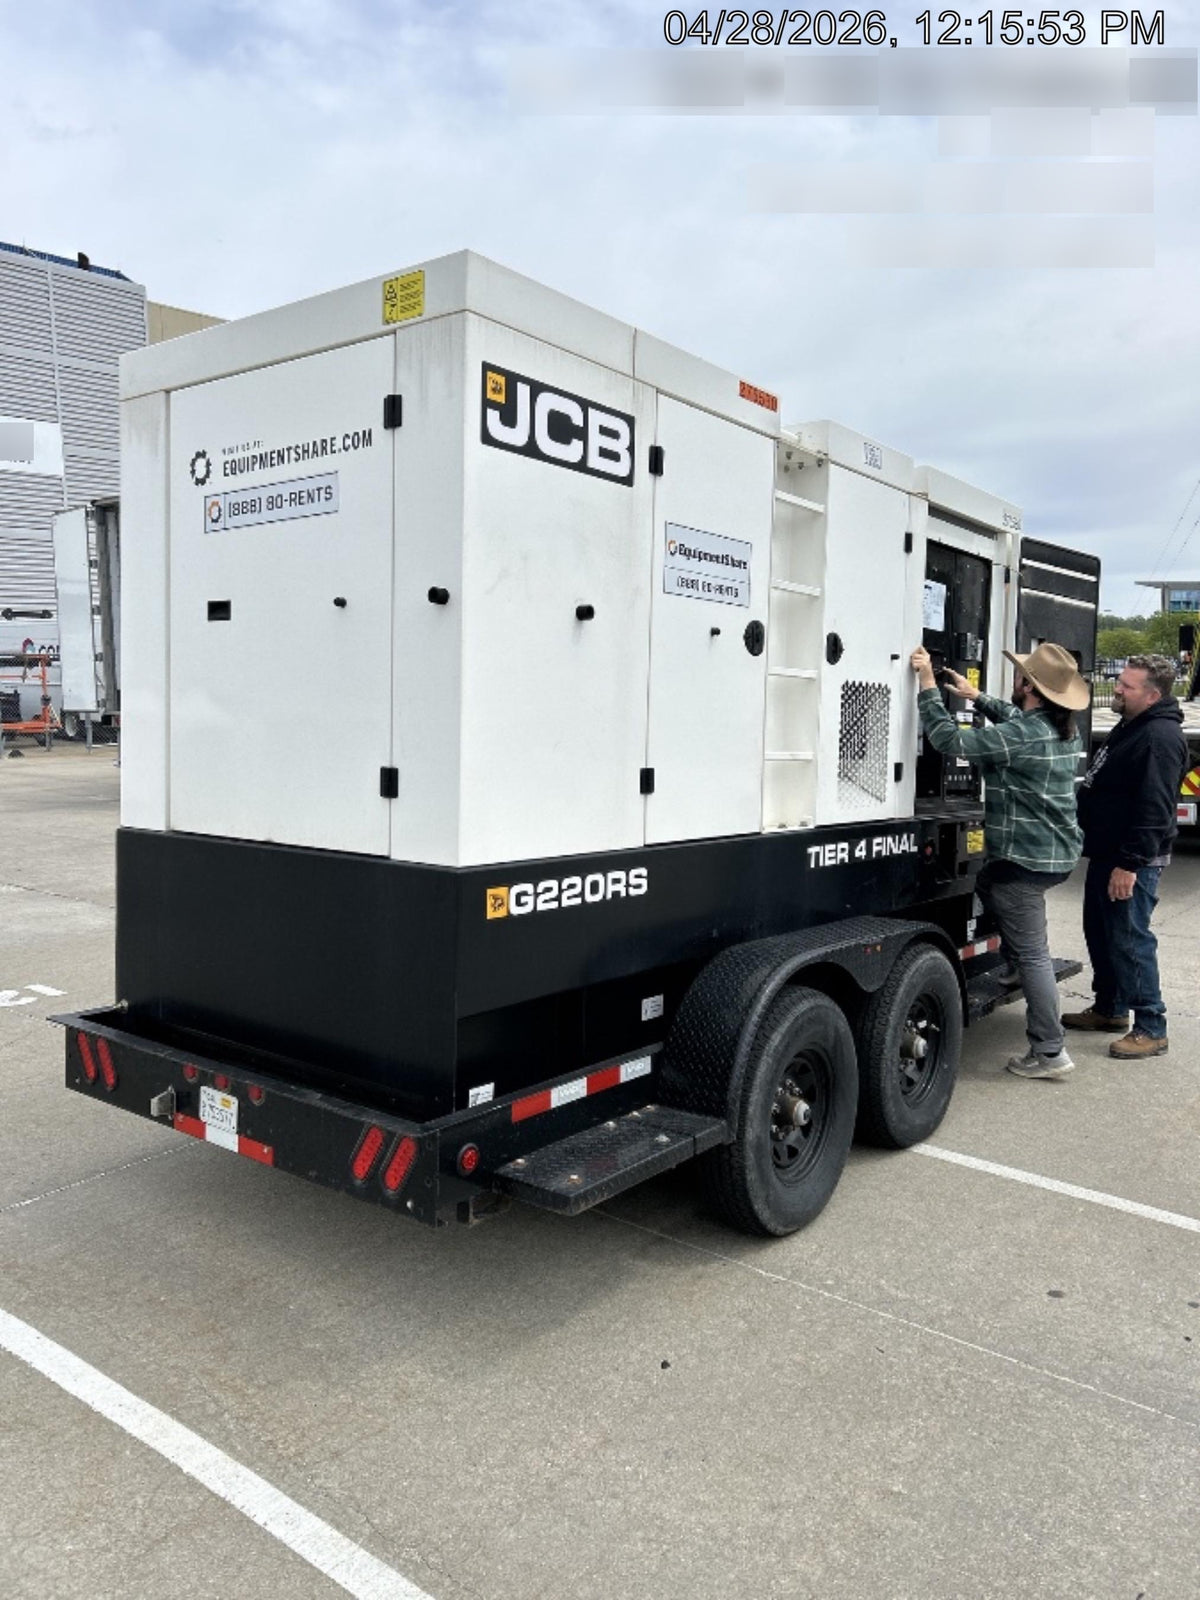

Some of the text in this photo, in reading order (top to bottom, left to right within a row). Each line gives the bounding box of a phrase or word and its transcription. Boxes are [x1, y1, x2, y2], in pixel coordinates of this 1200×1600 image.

[223, 428, 373, 477] EQUIPMENTSHARE.COM
[486, 381, 631, 477] JCB
[266, 485, 334, 511] 80-RENTS
[807, 833, 919, 868] TIER 4 FINAL
[509, 867, 648, 916] G220RS
